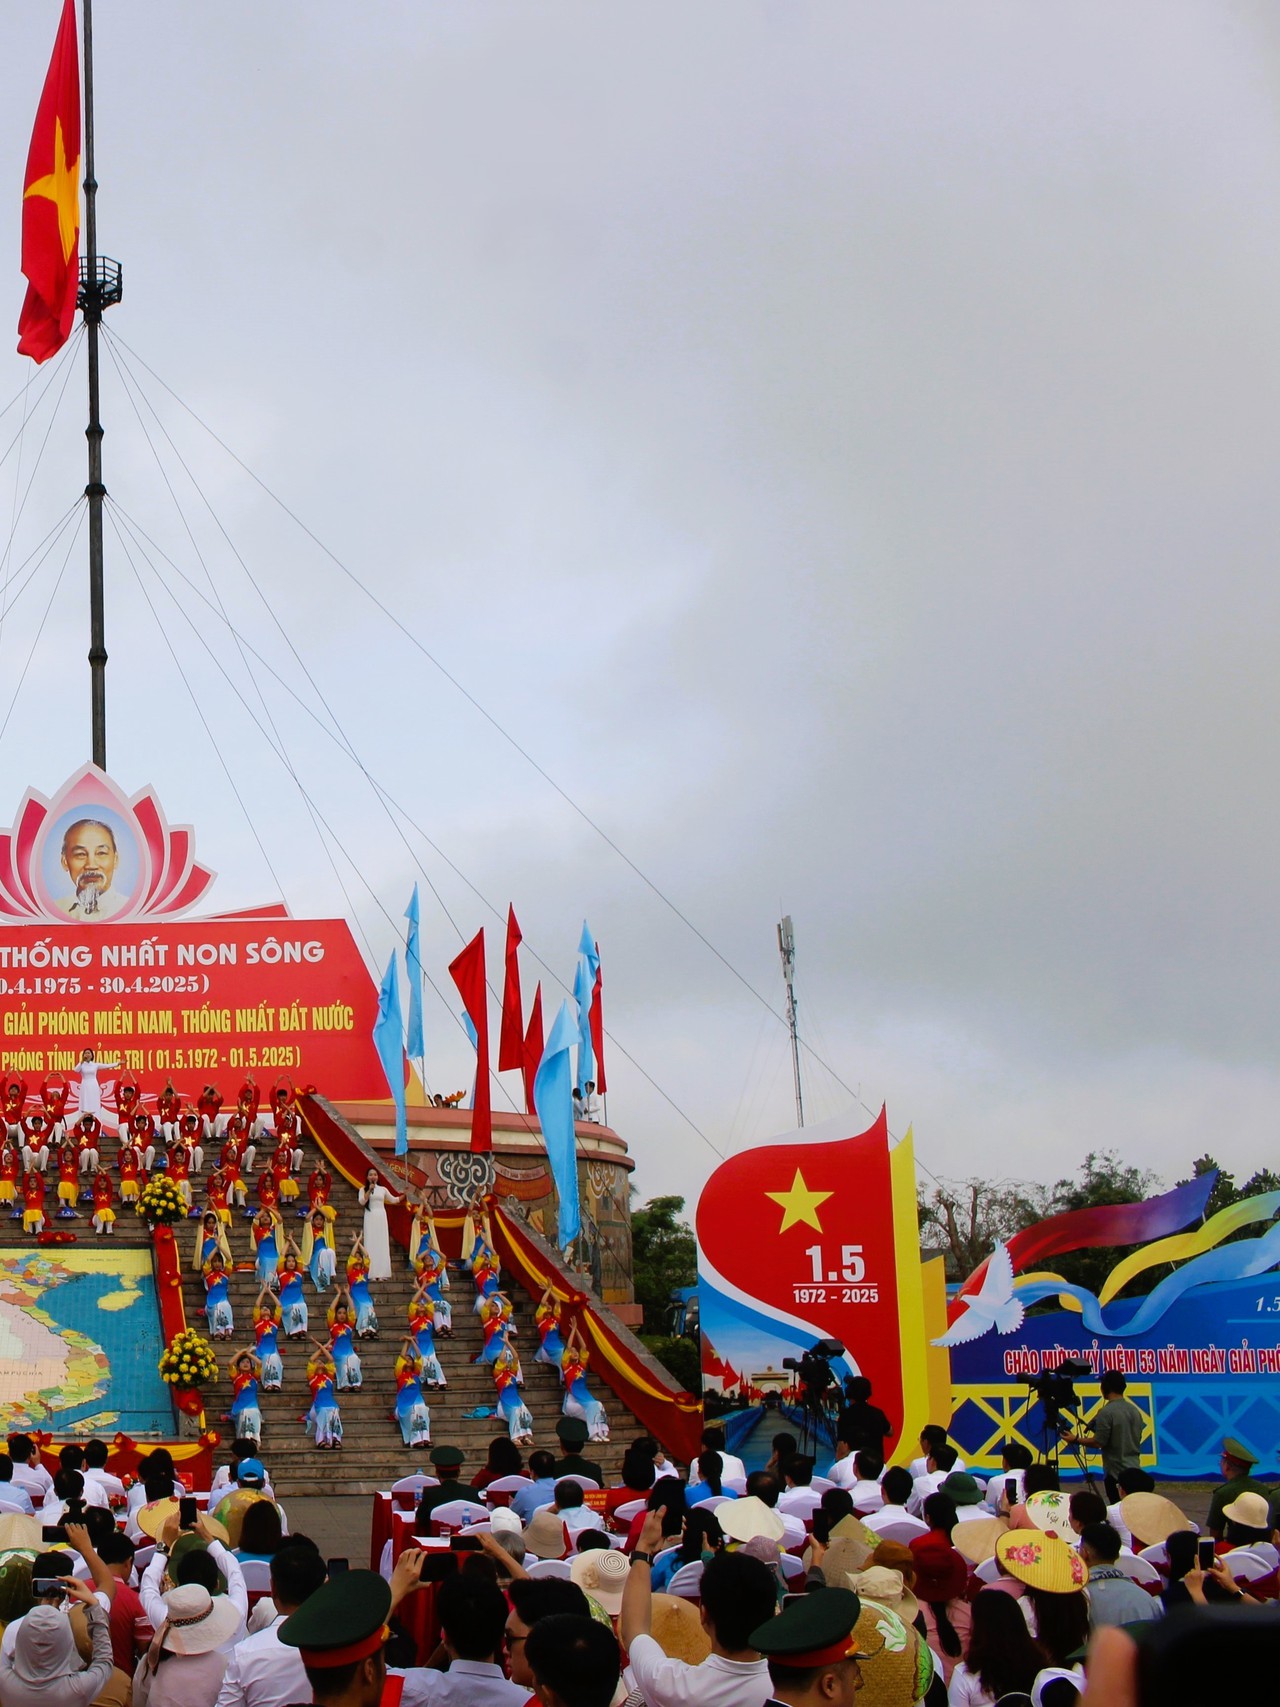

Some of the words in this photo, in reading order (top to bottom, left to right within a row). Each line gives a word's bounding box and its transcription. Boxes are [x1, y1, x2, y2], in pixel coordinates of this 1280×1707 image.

[101, 936, 169, 967] NHẤT
[177, 943, 237, 966] NON
[246, 937, 325, 964] SÔNG
[100, 974, 210, 994] 30.4.2025)
[4, 1002, 33, 1036] GIẢI
[38, 1005, 89, 1035] PHÓNG
[94, 1003, 133, 1035] MIỀN
[138, 1010, 177, 1036] NAM,
[182, 1001, 231, 1033] THỐNG
[235, 1000, 275, 1032] NHẤT
[279, 999, 308, 1031] ĐẤT
[312, 1000, 354, 1030] NƯỚC
[1, 1048, 44, 1072] PHÓNG
[47, 1044, 75, 1071] TỈNH
[125, 1049, 144, 1073] TRỊ
[156, 1048, 218, 1069] 01.5.1972
[230, 1046, 301, 1068] 01.5.2025)
[805, 1245, 865, 1282] 1.5
[793, 1289, 826, 1303] 1972
[842, 1289, 879, 1303] 2025
[1004, 1344, 1040, 1375] CHÀO
[1139, 1349, 1156, 1374] 53
[1158, 1344, 1190, 1374] NĂM
[1191, 1344, 1226, 1374] NGÀY
[1228, 1338, 1257, 1374] GIẢI
